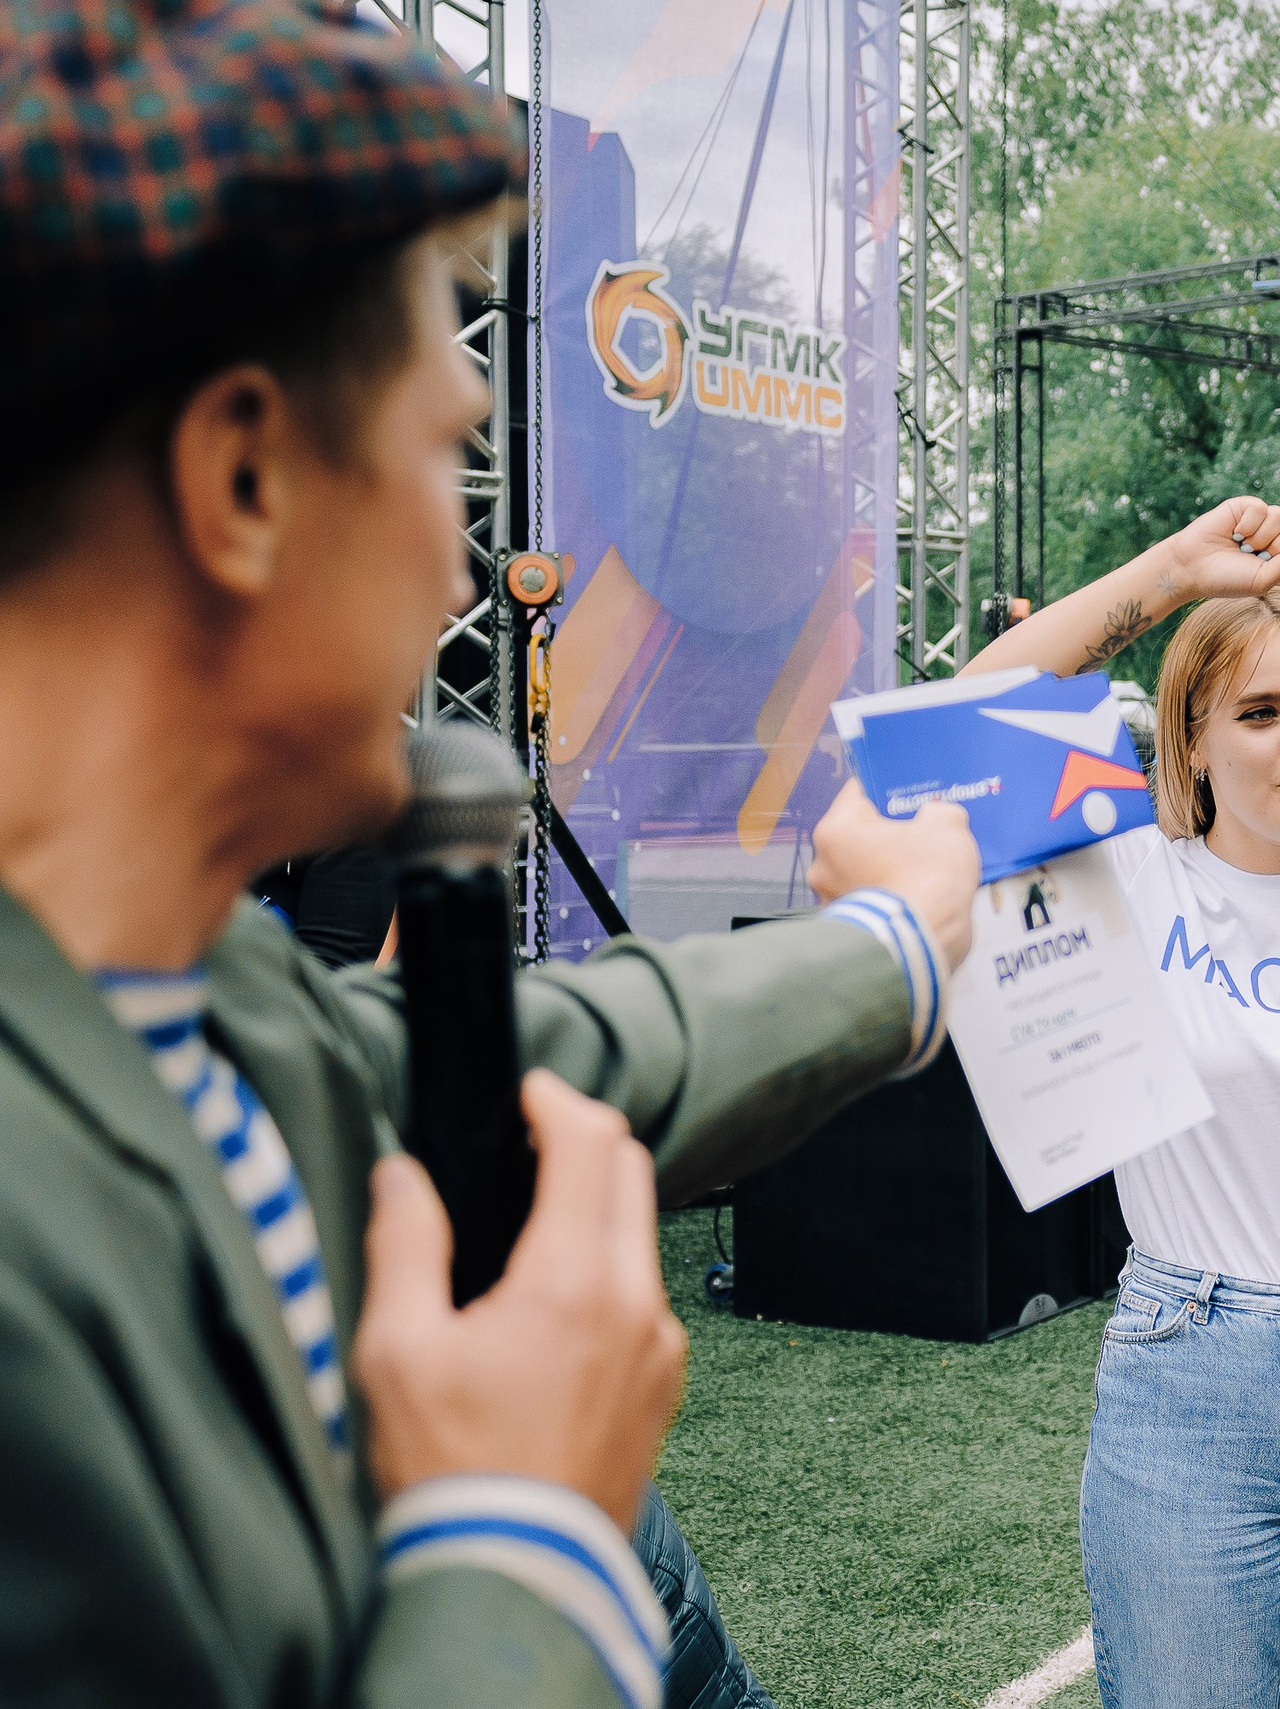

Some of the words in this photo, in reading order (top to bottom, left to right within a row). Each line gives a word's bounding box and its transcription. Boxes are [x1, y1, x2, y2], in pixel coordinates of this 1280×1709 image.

[697, 309, 842, 383] УГМК
[696, 361, 843, 428] UMMC
[994, 926, 1091, 988] ДИПЛОМ
